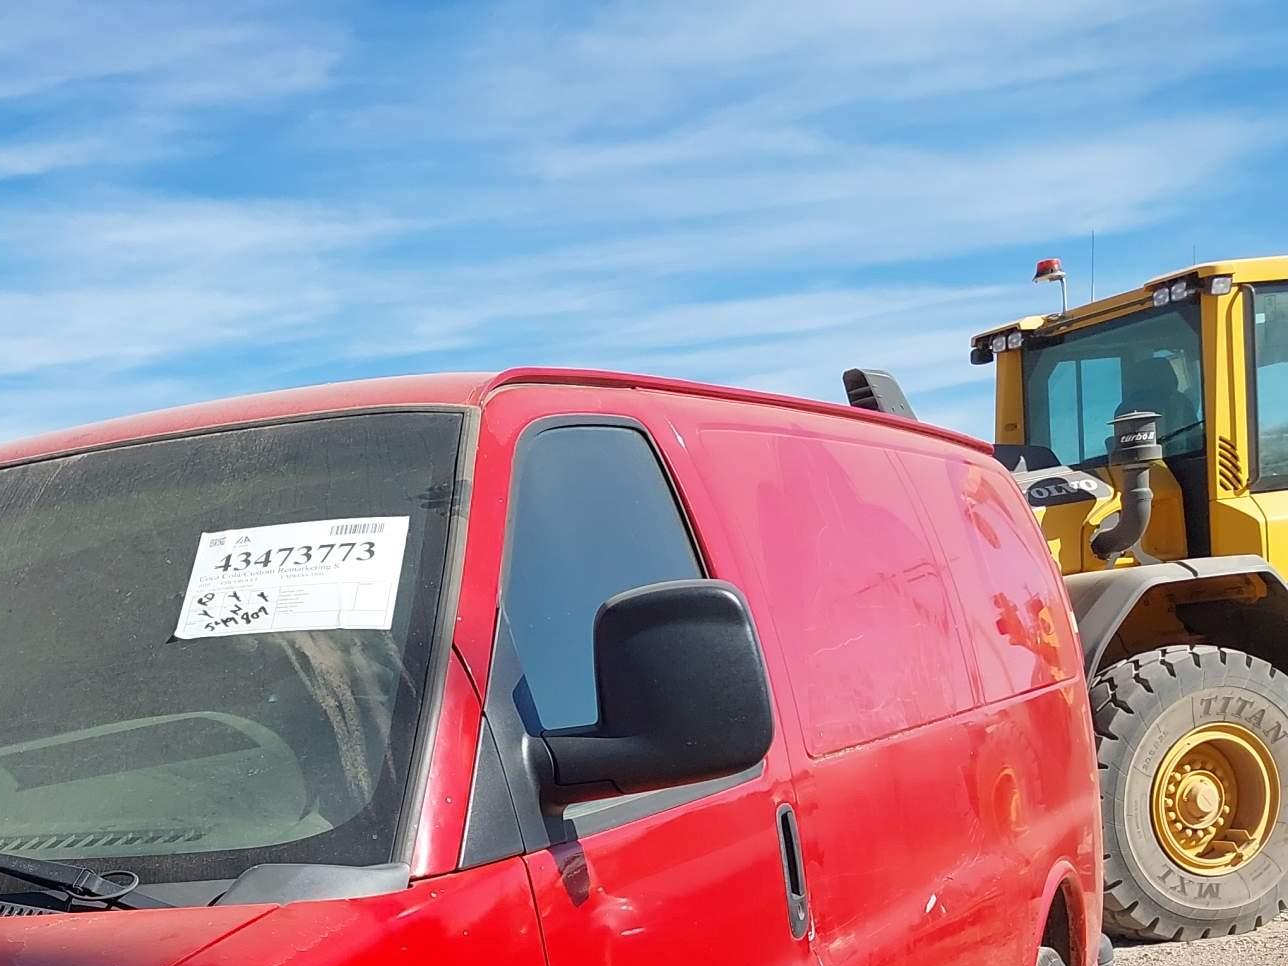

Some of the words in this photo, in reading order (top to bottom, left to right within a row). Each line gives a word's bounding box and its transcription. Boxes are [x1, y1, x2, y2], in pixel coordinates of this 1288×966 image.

[1029, 479, 1098, 499] OLVO
[214, 541, 376, 572] 43473773
[1199, 695, 1288, 745] TITAN
